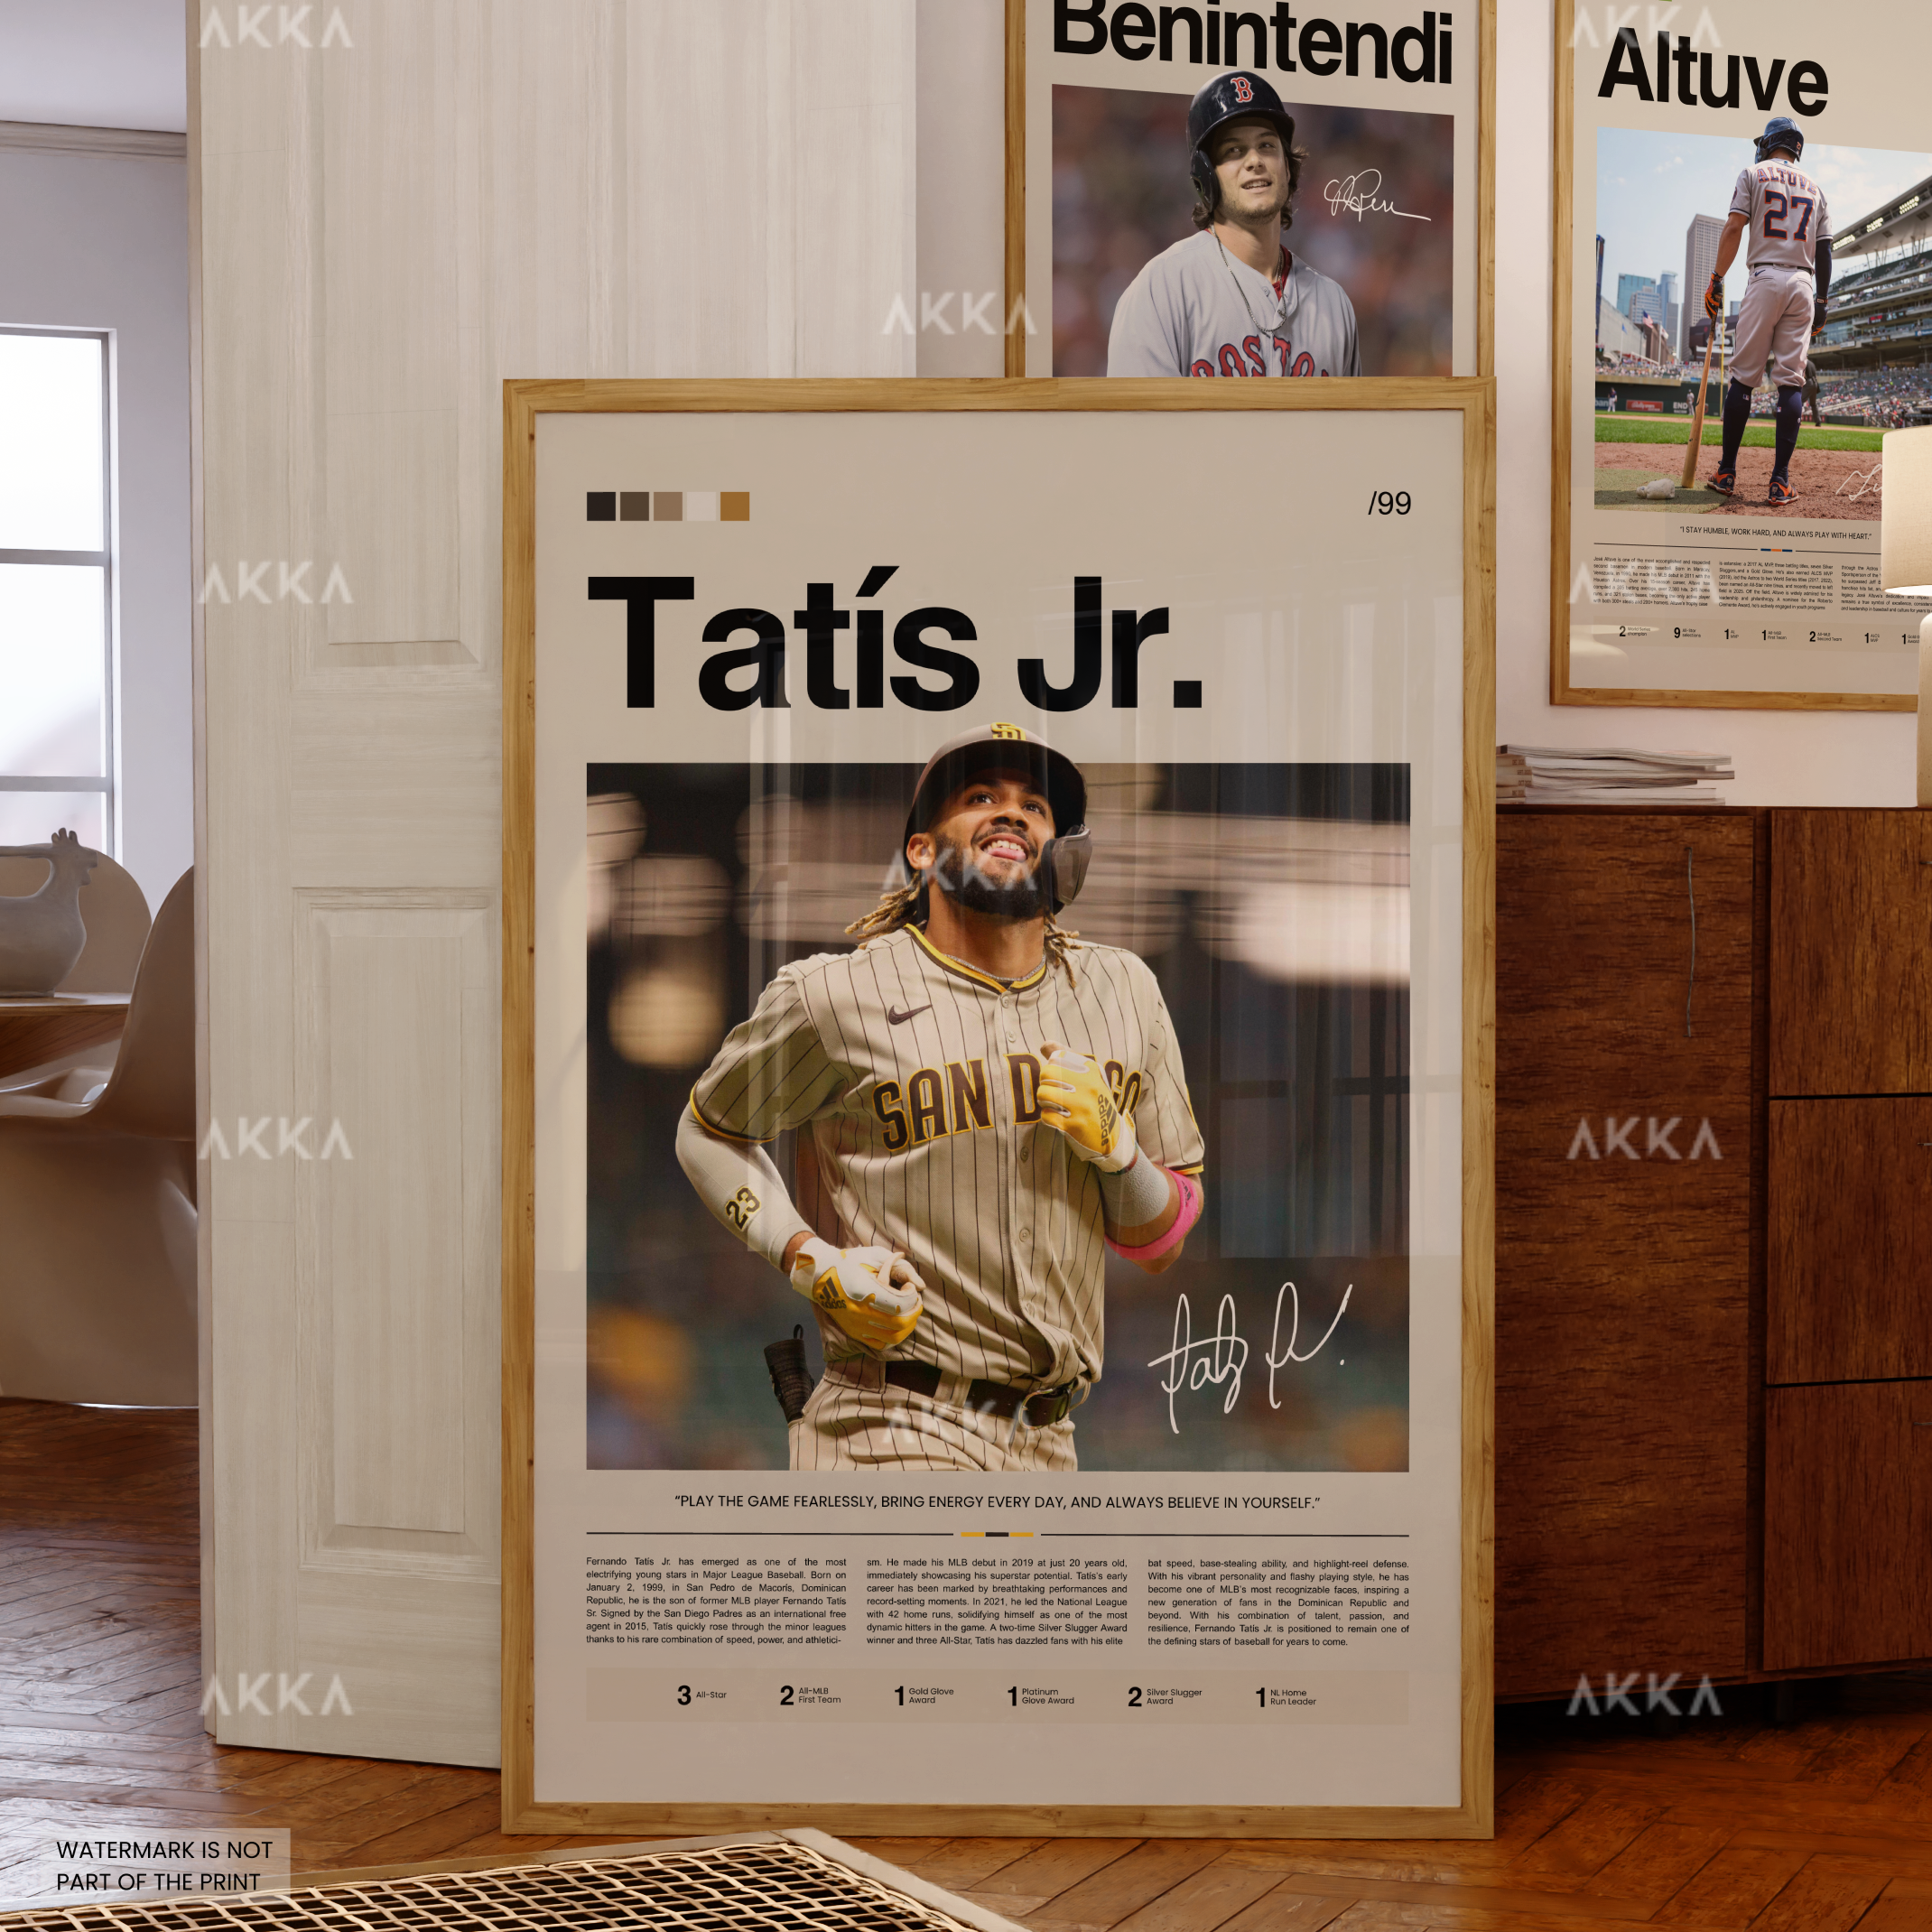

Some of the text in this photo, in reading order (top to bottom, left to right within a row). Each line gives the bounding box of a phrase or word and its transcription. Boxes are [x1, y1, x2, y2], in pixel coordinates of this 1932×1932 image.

[1053, 0, 1453, 85] Benintendi
[1598, 27, 1829, 117] Altuve
[1231, 76, 1254, 104] B
[1757, 167, 1817, 196] ALTUVE
[1763, 189, 1815, 243] 27
[1368, 490, 1412, 516] /99
[1685, 525, 1703, 534] STAY
[1702, 525, 1731, 536] HUMBLE,
[1730, 526, 1751, 536] WORK
[1751, 527, 1772, 538] HARD,
[1771, 528, 1788, 538] AND
[1786, 529, 1814, 538] ALWAYS
[1814, 530, 1830, 539] PLAY
[1829, 531, 1847, 540] WITH
[1619, 626, 1627, 637] 2
[1674, 627, 1681, 638] 9
[1724, 628, 1730, 640] 1
[1761, 629, 1767, 641] 1
[1809, 631, 1816, 642] 2
[1864, 632, 1870, 644] 1
[587, 565, 1203, 712] Tatís Jr.
[1901, 634, 1907, 645] 1
[872, 1053, 1142, 1152] SAN DGO
[725, 1186, 761, 1231] 23
[717, 1494, 744, 1508] THE
[747, 1494, 790, 1508] GAME
[793, 1494, 878, 1509] FEARLESSLY,
[880, 1494, 925, 1509] BRING
[928, 1494, 984, 1509] ENERGY
[987, 1495, 1031, 1509] EVERY
[1034, 1495, 1067, 1510] DAY,
[1070, 1495, 1101, 1509] AND
[1104, 1495, 1164, 1509] ALWAYS
[1167, 1495, 1220, 1509] BELIEVE
[1223, 1496, 1238, 1509] IN
[585, 1556, 627, 1566] Fernando
[660, 1556, 671, 1566] Jr.
[677, 1556, 694, 1566] has
[700, 1556, 739, 1568] emerged
[745, 1558, 757, 1566] as
[763, 1558, 781, 1566] one
[786, 1556, 797, 1566] of
[803, 1556, 819, 1566] the
[824, 1557, 847, 1566] most
[866, 1556, 1128, 1570] sm. He made his MLB debut in 2019 at just 20 years old,
[1147, 1557, 1409, 1571] bat speed, base-stealing ability, and highlight-reel defense.
[585, 1568, 847, 1581] electrifying young stars in Major League Baseball. Born on
[676, 1684, 692, 1706] 3
[694, 1690, 728, 1699] All-Star
[779, 1684, 794, 1706] 2
[797, 1686, 829, 1695] All-MLB
[893, 1685, 905, 1706] 1
[907, 1686, 954, 1695] Gold Glove
[1007, 1685, 1017, 1707] 1
[1021, 1686, 1059, 1696] Platinum
[1127, 1686, 1143, 1707] 2
[1146, 1687, 1203, 1699] Silver Slugger
[1254, 1686, 1266, 1708] 1
[1269, 1688, 1307, 1697] NL Home
[797, 1695, 841, 1704] First Team
[907, 1695, 936, 1704] Award
[1020, 1695, 1075, 1704] Glove Award
[1145, 1695, 1174, 1705] Award
[1269, 1696, 1317, 1705] Run Leader
